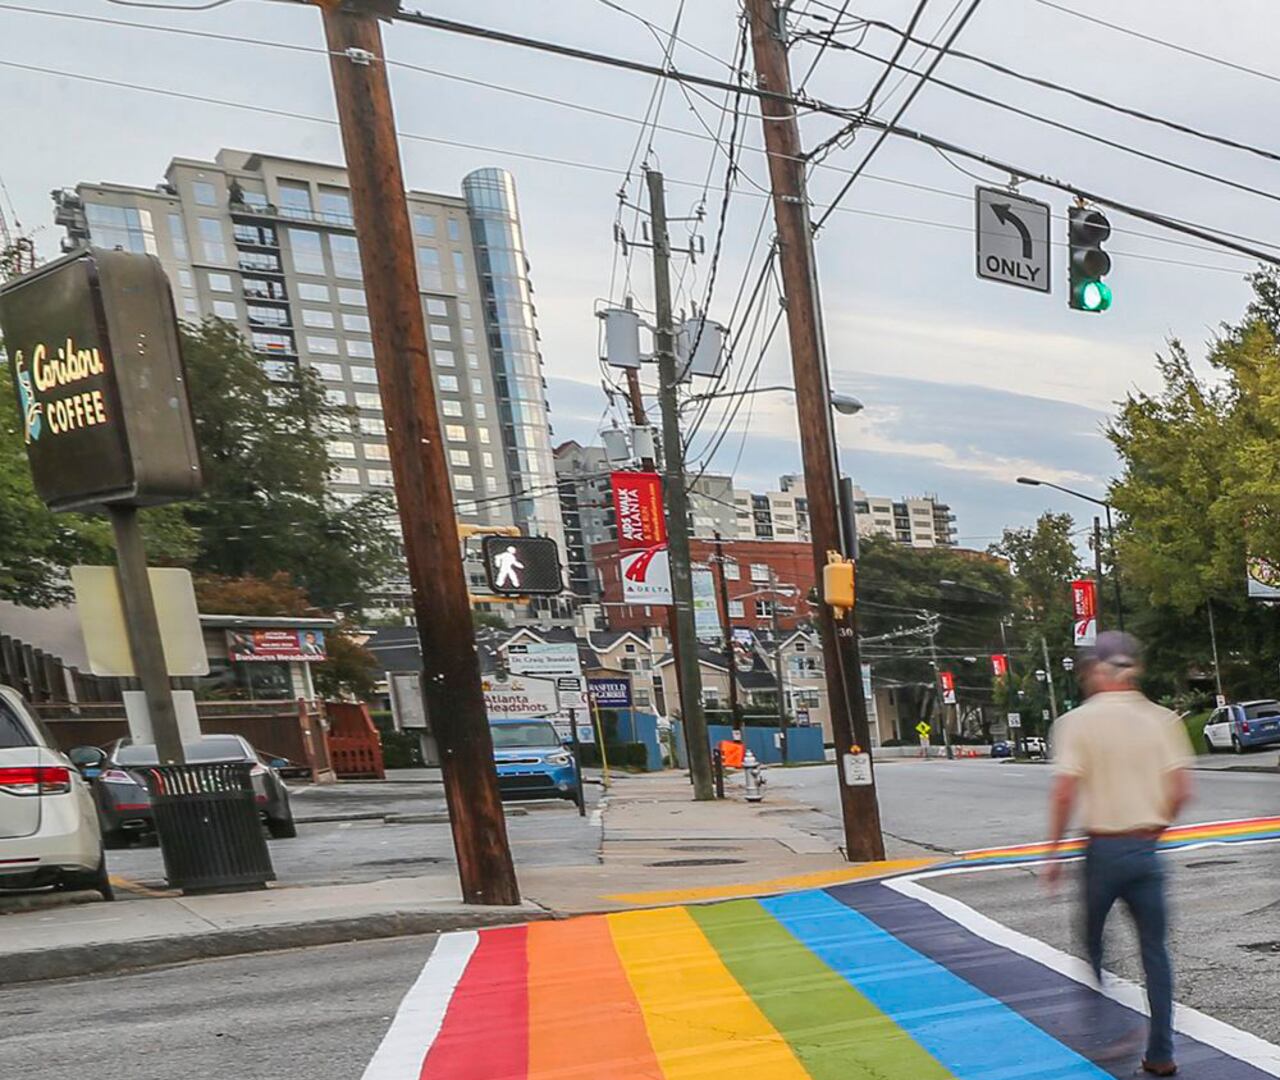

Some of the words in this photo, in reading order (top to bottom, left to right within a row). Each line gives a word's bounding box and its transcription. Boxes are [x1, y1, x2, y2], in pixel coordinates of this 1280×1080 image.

[986, 255, 1041, 282] ONLY
[33, 338, 104, 391] Caribou
[47, 390, 106, 434] COFFEE
[618, 488, 630, 515] WALK
[628, 489, 644, 541] ATLANTA
[621, 518, 633, 540] AIDS
[484, 695, 529, 703] Atlanta
